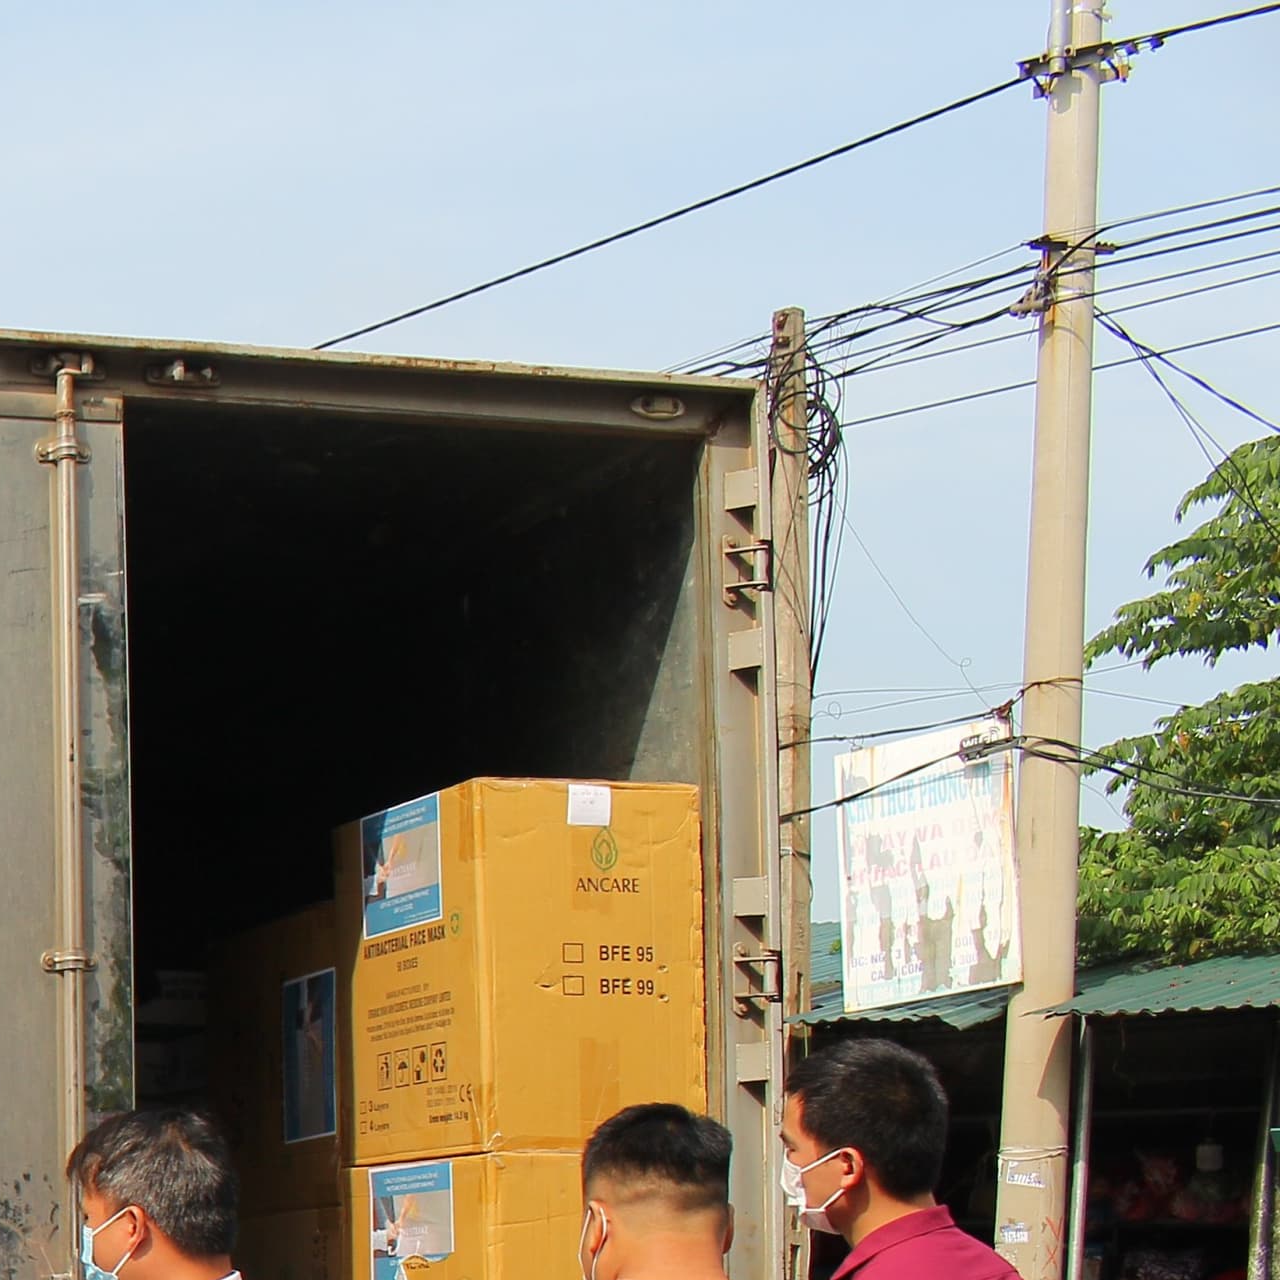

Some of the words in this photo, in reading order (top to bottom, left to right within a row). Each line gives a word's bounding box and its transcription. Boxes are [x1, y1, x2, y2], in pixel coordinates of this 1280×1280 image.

[576, 877, 640, 894] ANCARE
[599, 945, 631, 962] BFE
[637, 945, 654, 962] 95
[599, 979, 632, 996] BFE
[637, 979, 654, 996] 99
